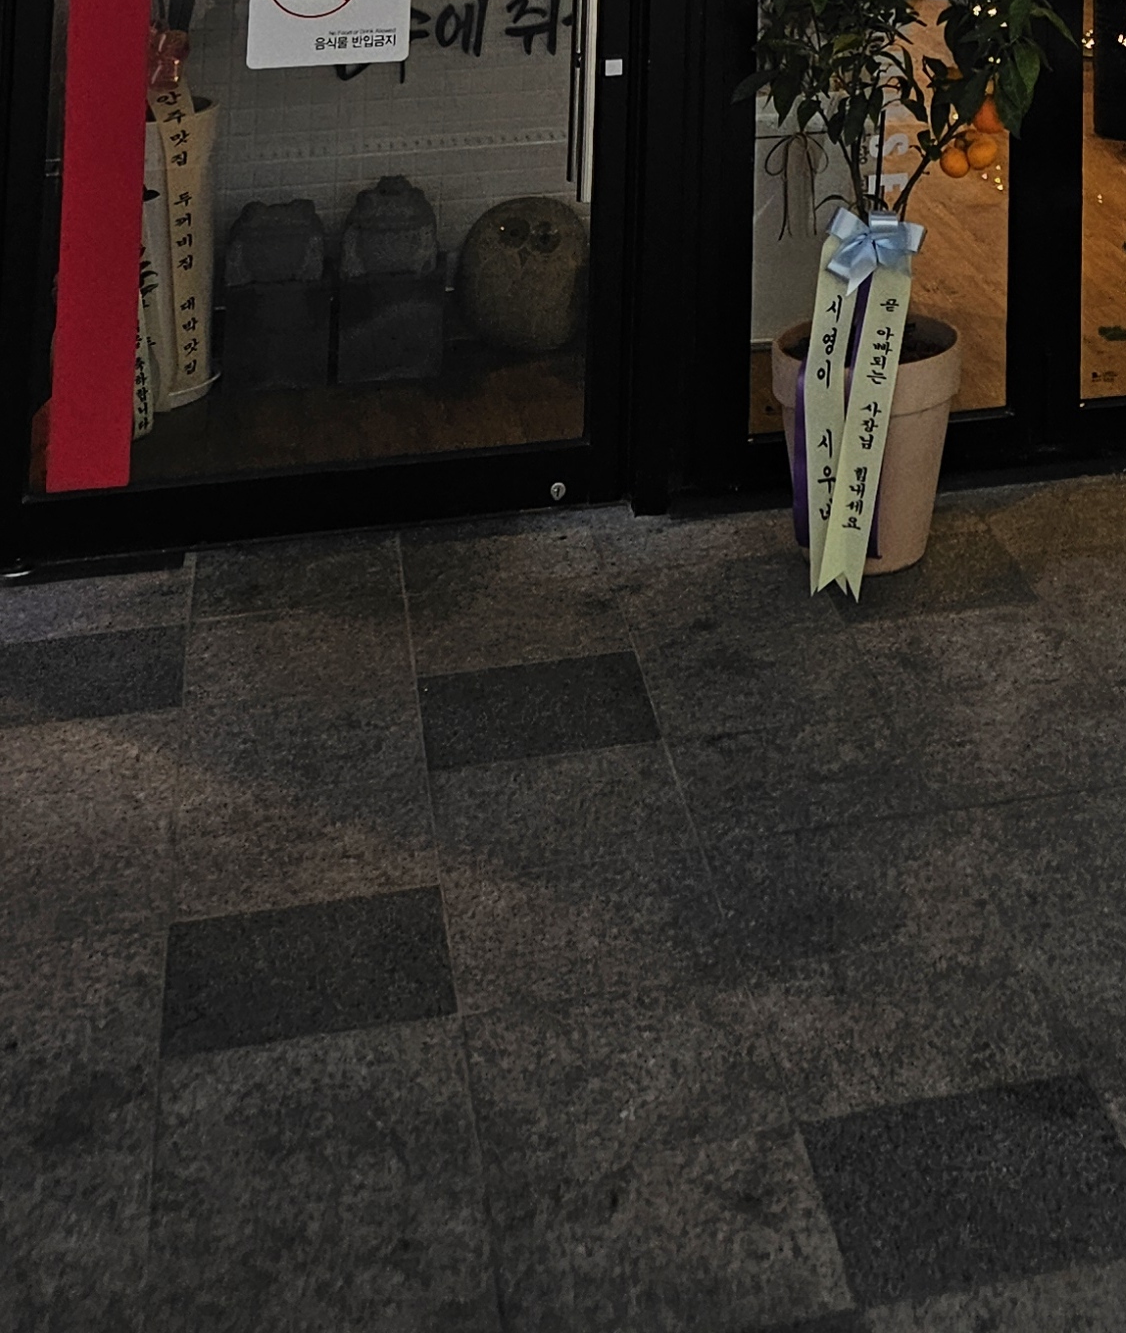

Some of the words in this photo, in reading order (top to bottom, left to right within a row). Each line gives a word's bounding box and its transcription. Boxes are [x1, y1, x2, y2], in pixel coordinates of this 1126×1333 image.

[314, 36, 348, 51] 음식물
[351, 34, 397, 48] 반입금지
[816, 294, 844, 389] 시영이
[866, 326, 895, 385] 아빠되는
[859, 400, 882, 451] 사장님
[841, 466, 869, 532] 힘내세요
